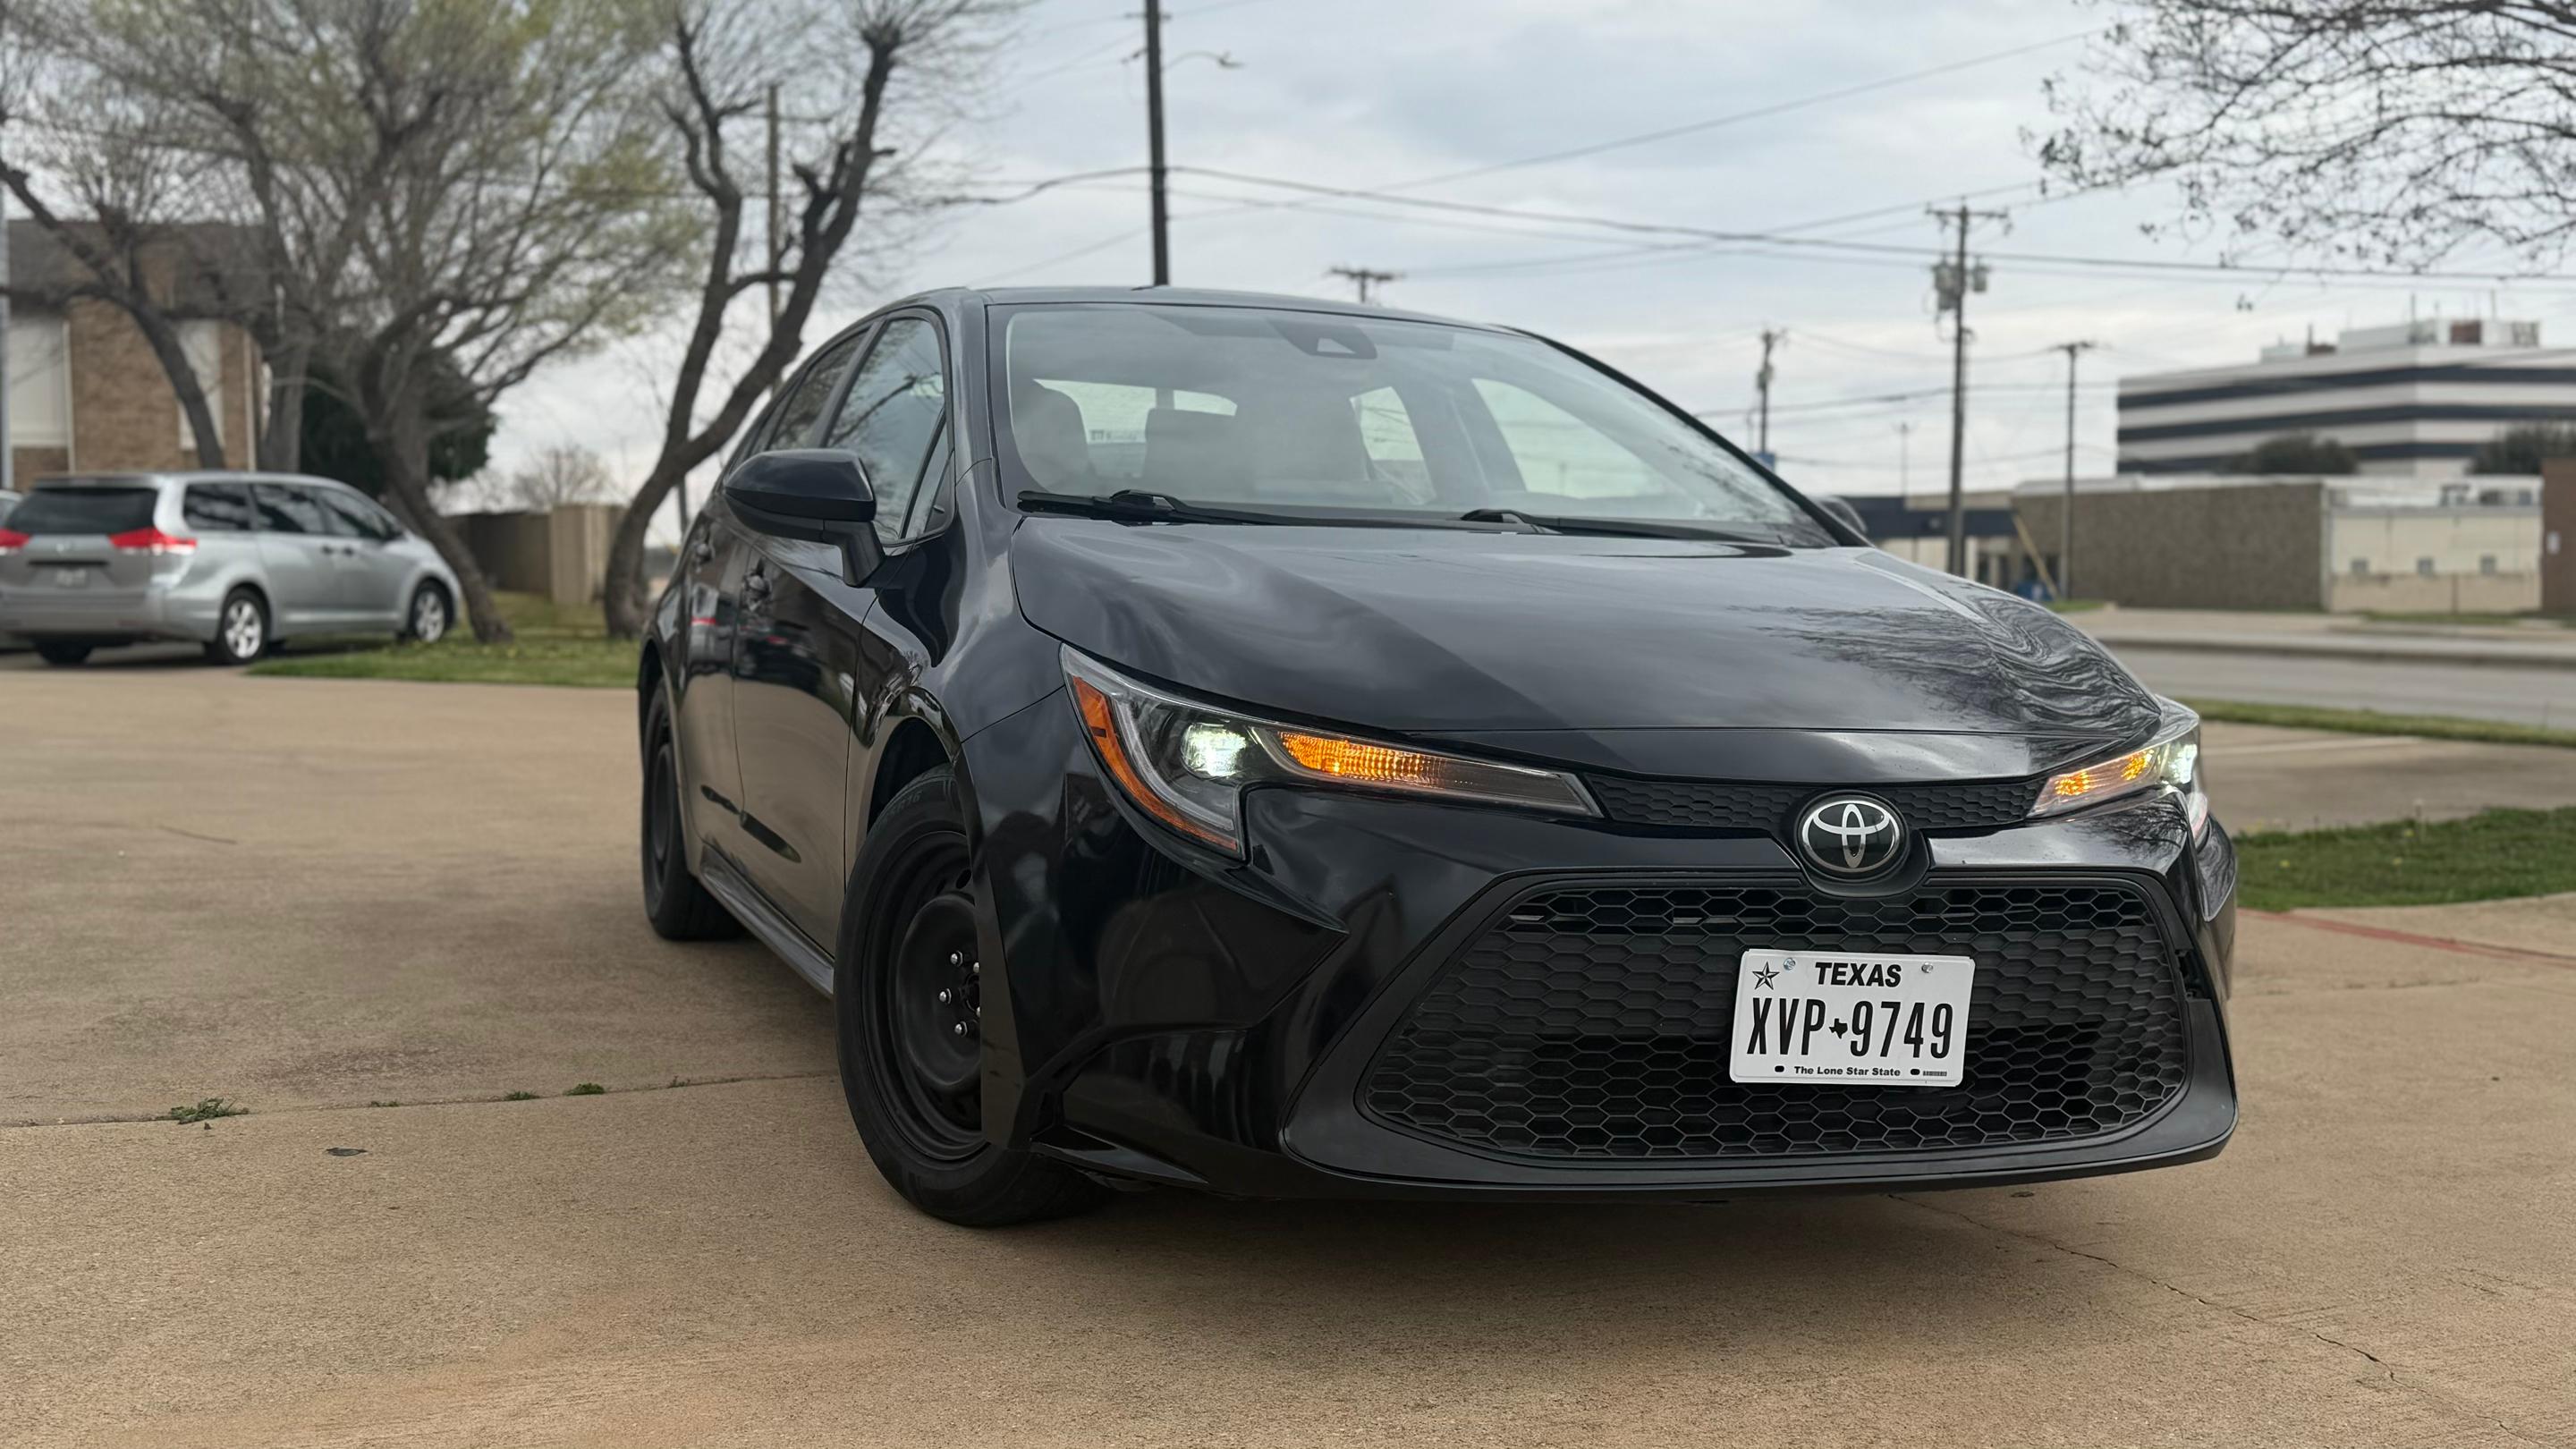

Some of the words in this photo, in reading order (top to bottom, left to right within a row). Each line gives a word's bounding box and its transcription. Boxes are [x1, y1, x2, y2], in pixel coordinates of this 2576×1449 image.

[1814, 962, 1902, 988] TEXAS
[1746, 996, 1826, 1056] XVP
[1850, 1000, 1953, 1059] 9749
[1793, 1065, 1815, 1076] The
[1817, 1065, 1844, 1076] Lone
[1845, 1066, 1869, 1076] Star
[1871, 1067, 1901, 1077] State
